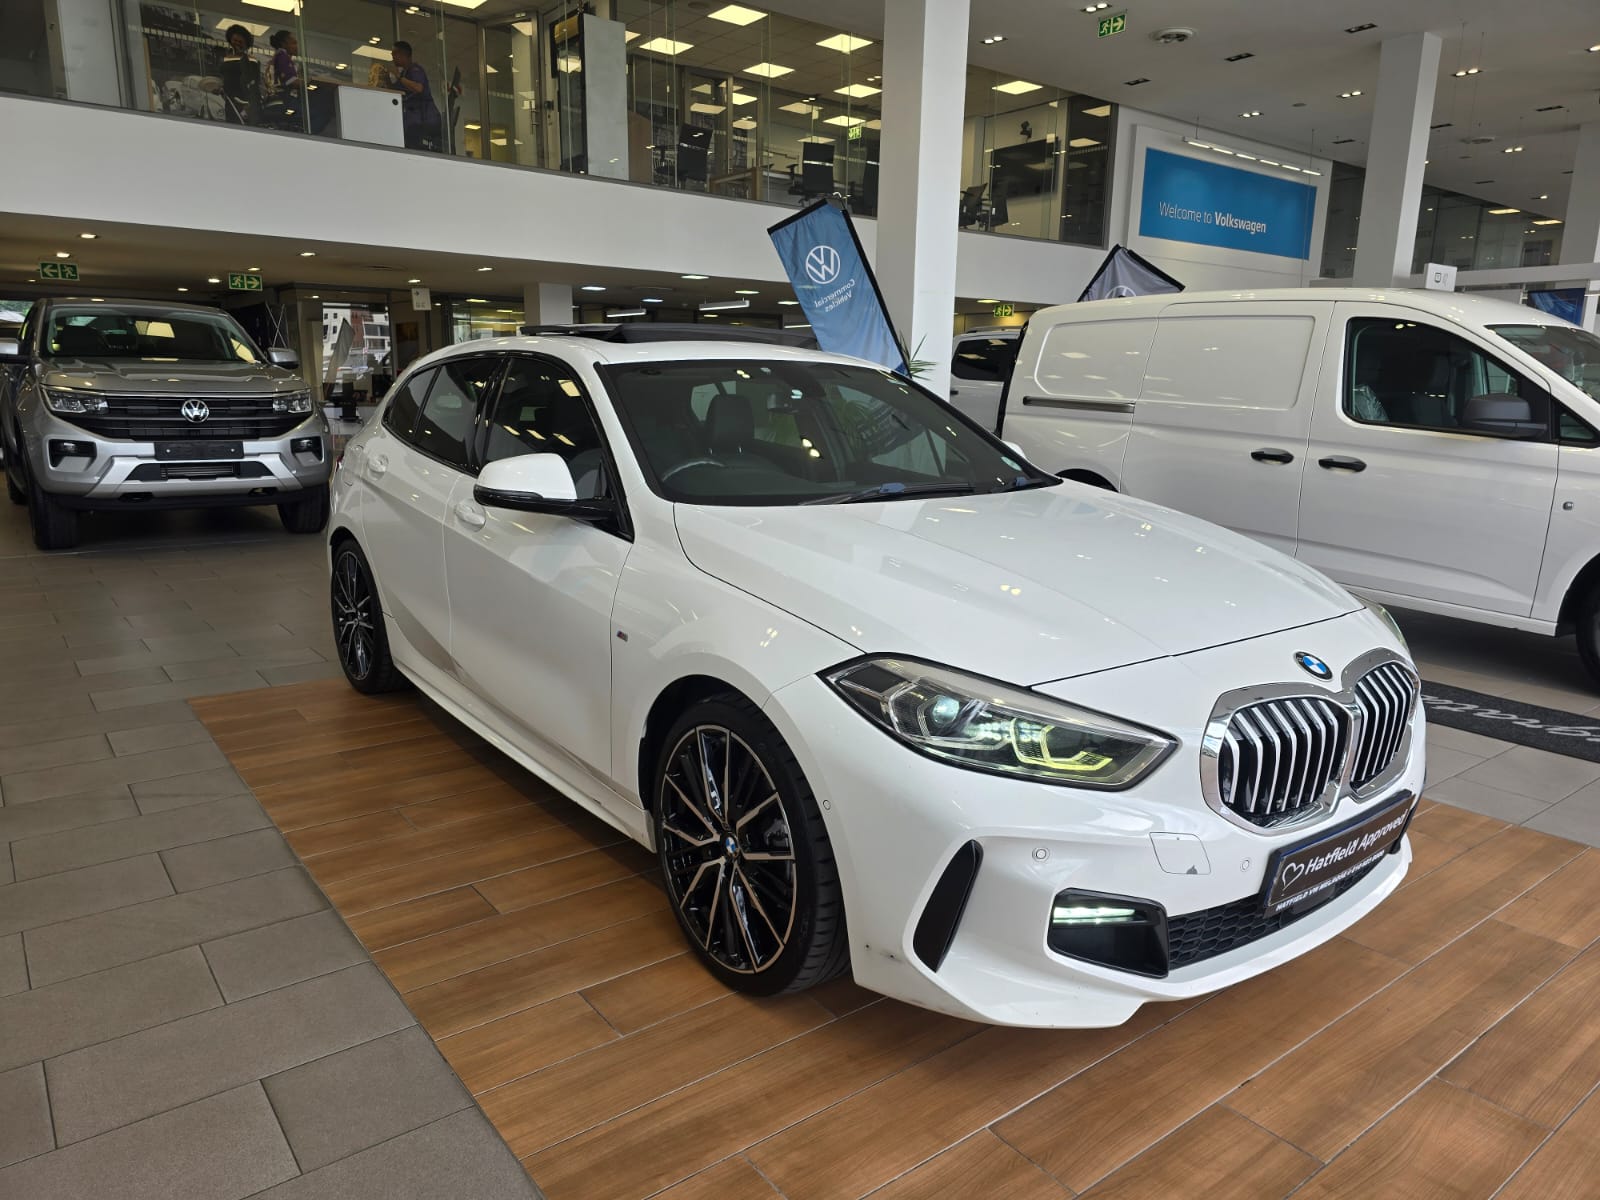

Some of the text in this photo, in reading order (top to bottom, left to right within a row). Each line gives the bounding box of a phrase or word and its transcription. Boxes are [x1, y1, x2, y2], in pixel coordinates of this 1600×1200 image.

[1160, 201, 1267, 234] Welcome to Volkswagen
[1304, 837, 1360, 875] Hatfield
[1358, 808, 1409, 851] Approved
